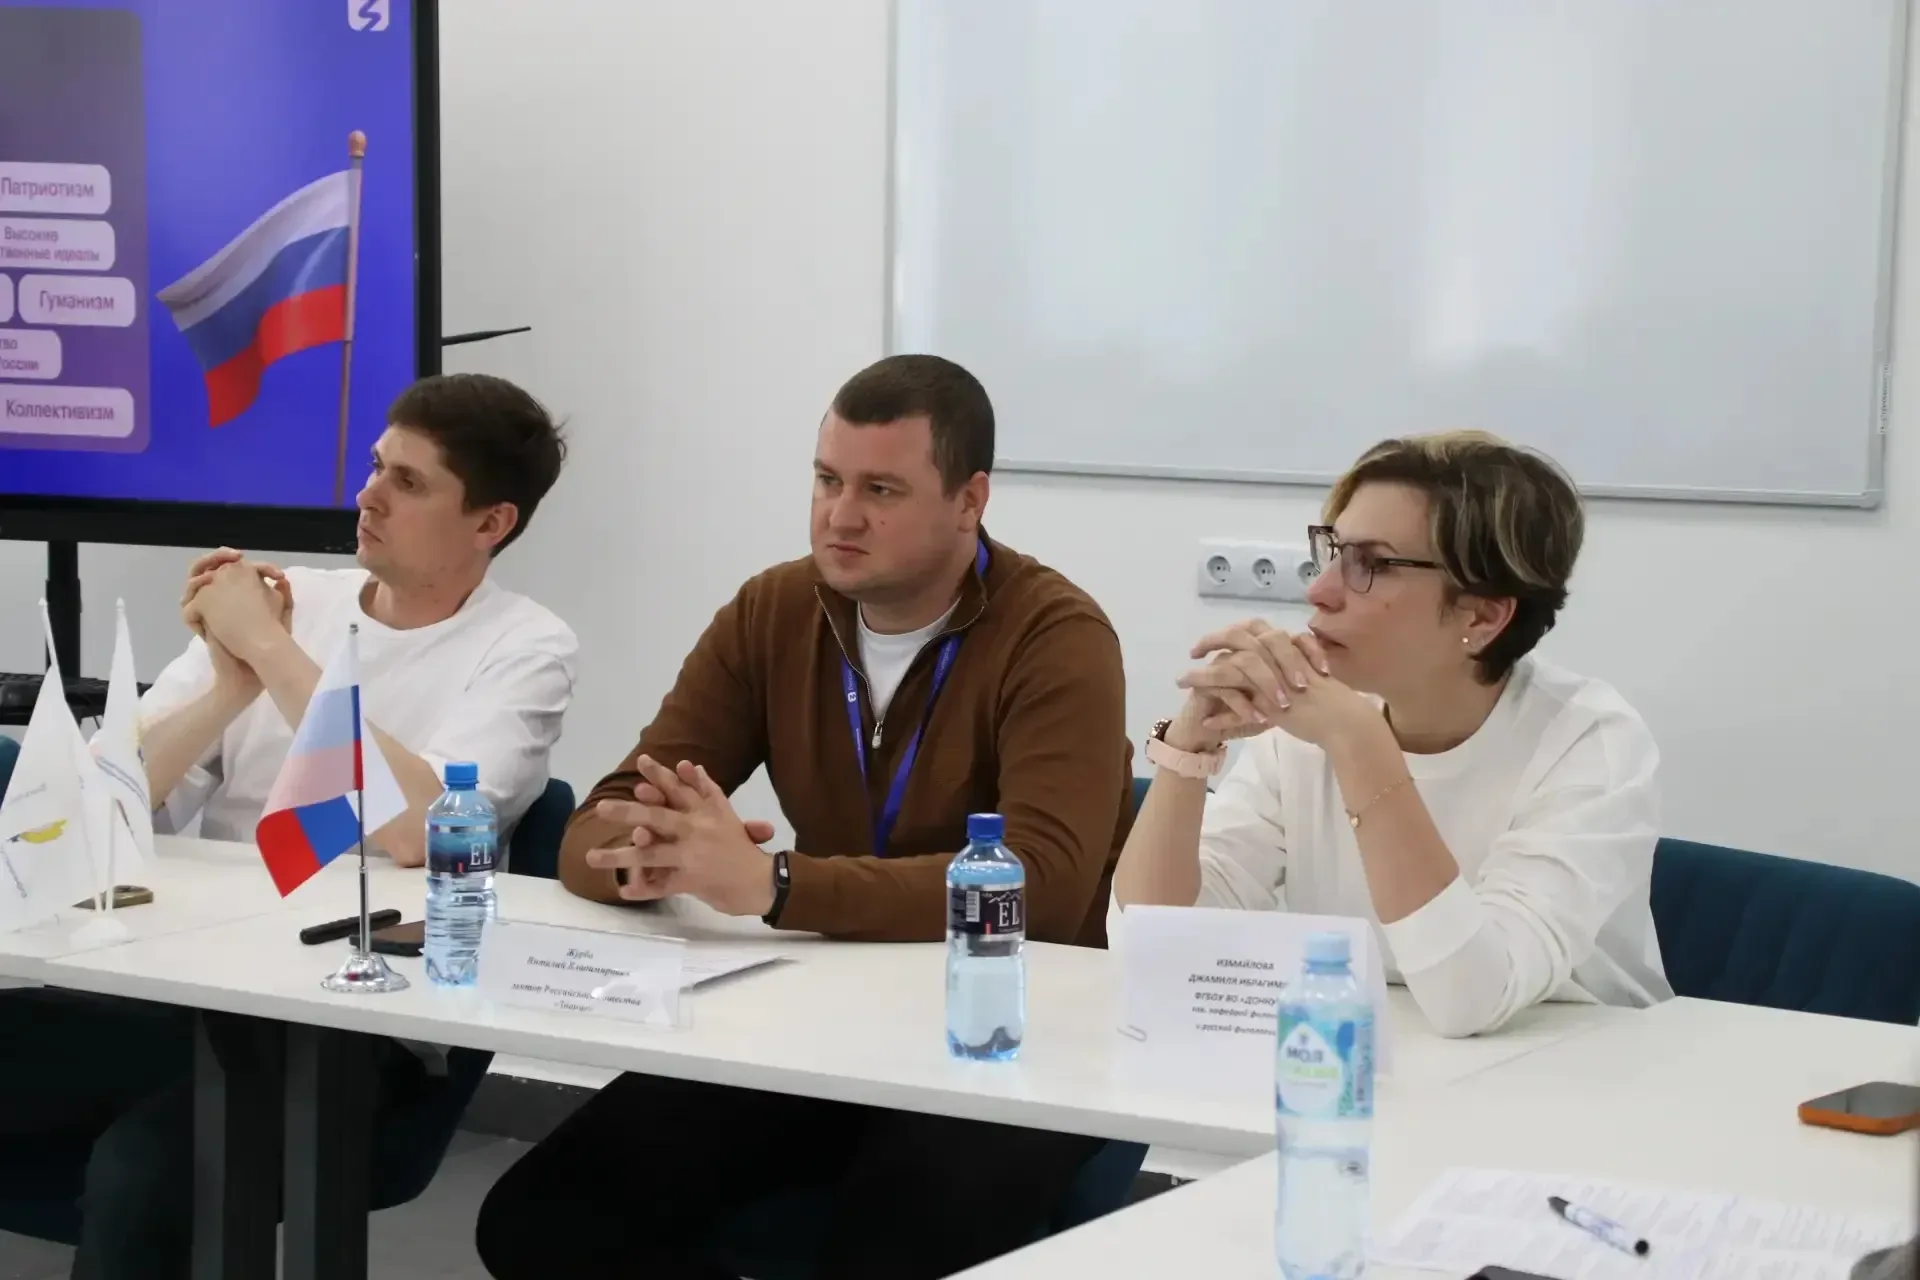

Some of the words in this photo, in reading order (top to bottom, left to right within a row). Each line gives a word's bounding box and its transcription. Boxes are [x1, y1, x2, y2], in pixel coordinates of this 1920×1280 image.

[1, 177, 95, 200] Патриотизм
[4, 226, 59, 241] Высокие
[40, 290, 115, 312] Гуманизм
[0, 356, 39, 371] оссии
[6, 399, 114, 421] Коллективизм
